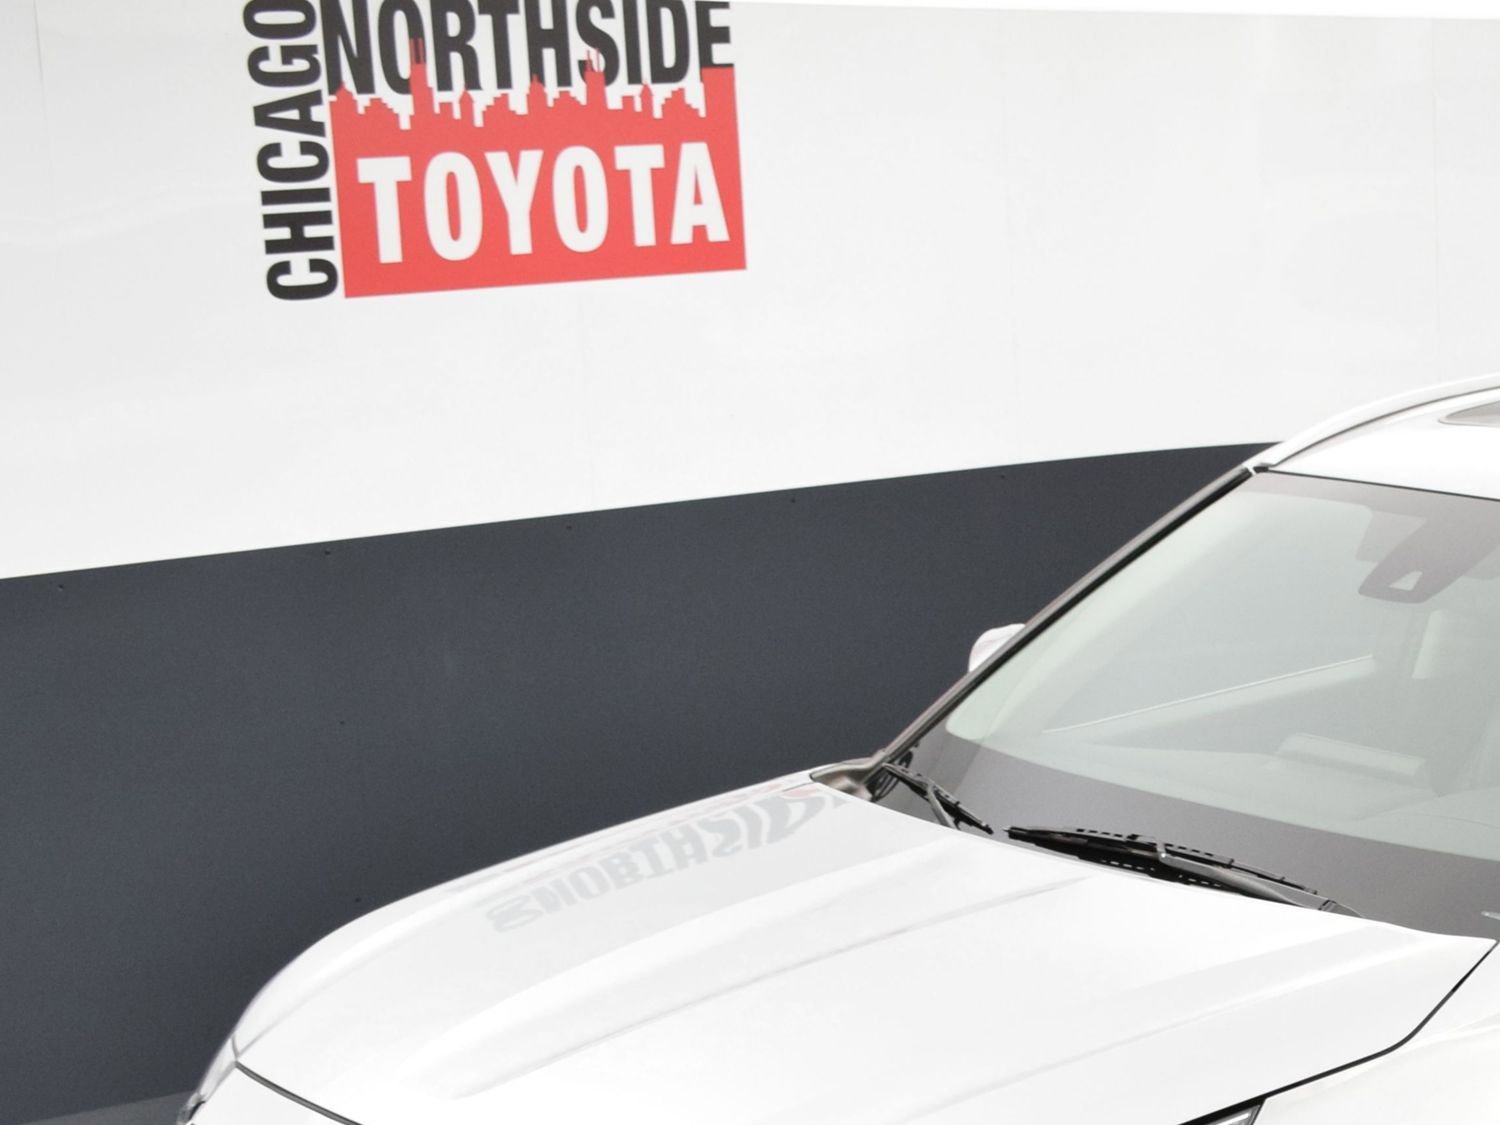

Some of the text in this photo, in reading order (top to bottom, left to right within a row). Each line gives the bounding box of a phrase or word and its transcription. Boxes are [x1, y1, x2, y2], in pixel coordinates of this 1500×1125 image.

[320, 0, 734, 96] NORTHSIDE
[242, 0, 339, 301] CHICAGO
[356, 141, 731, 264] TOYOTA
